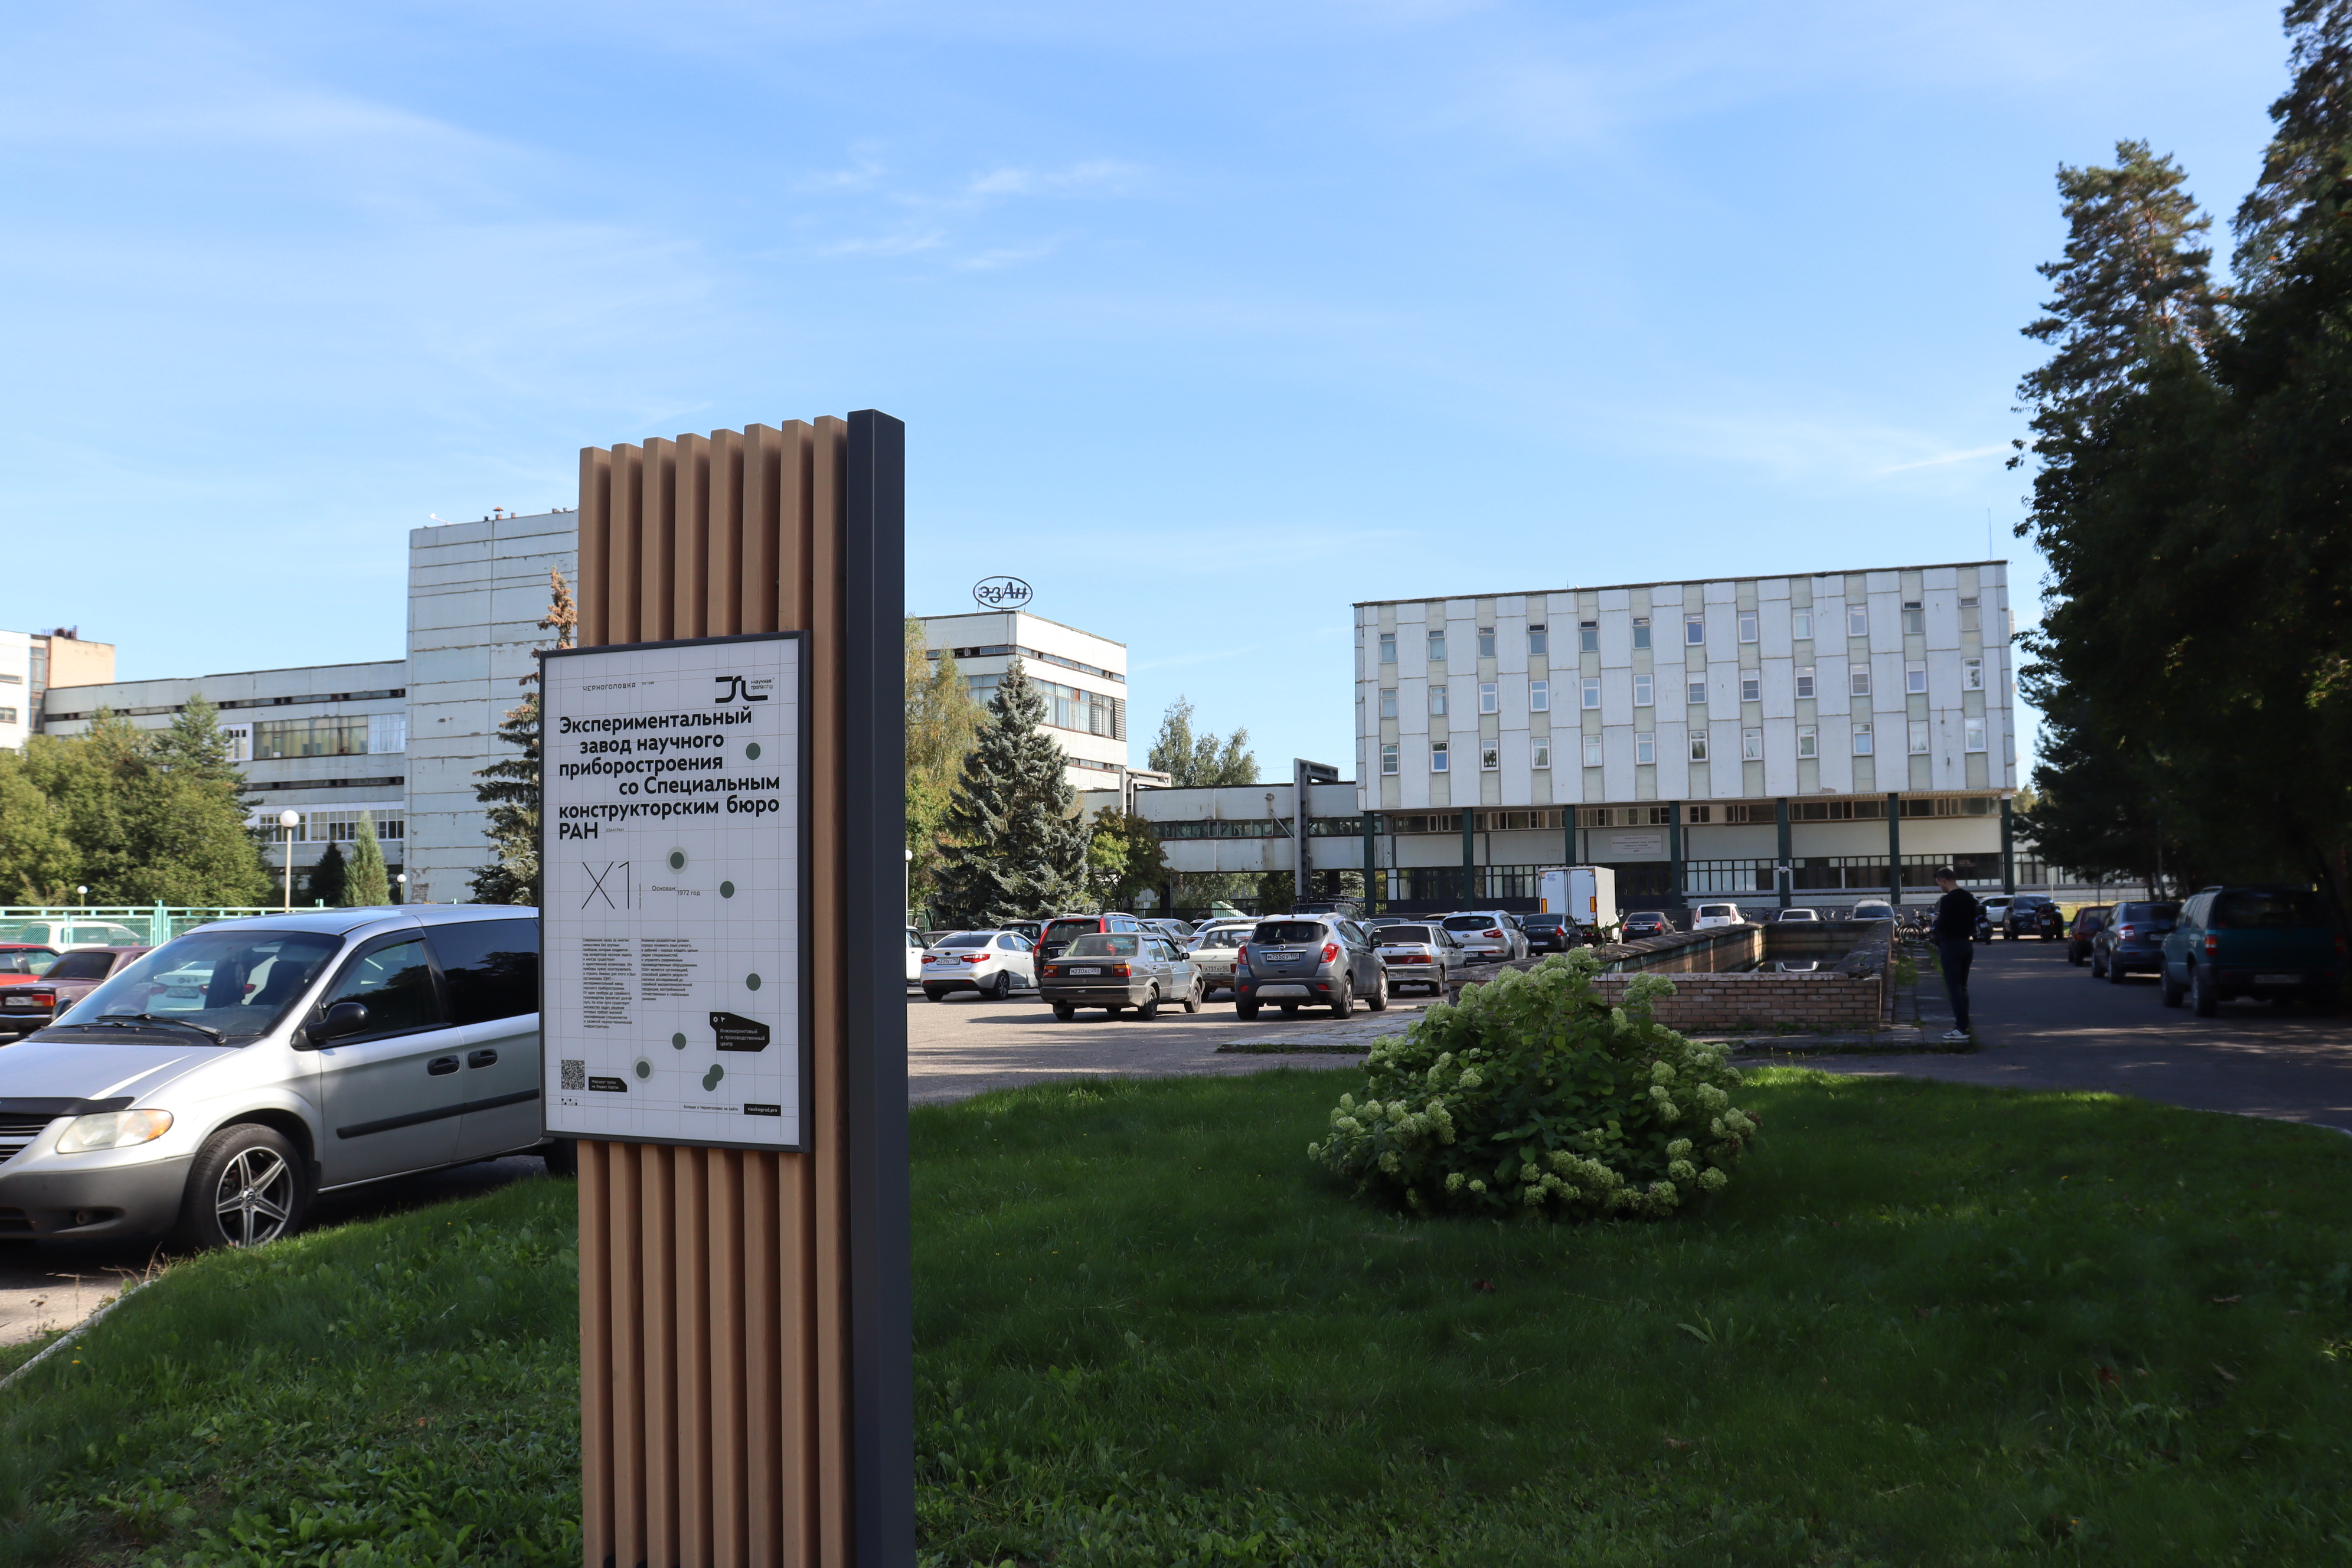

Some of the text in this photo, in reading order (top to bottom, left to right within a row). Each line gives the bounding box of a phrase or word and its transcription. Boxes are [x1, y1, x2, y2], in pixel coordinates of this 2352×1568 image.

[583, 682, 636, 691] ЧЕРНОГОЛОВКА
[560, 705, 752, 736] Экспериментальный
[580, 734, 724, 755] завод научного
[559, 756, 723, 780] приборостроения
[619, 776, 779, 796] со Специальным
[559, 794, 779, 822] конструкторским бюро
[559, 822, 598, 840] РАН
